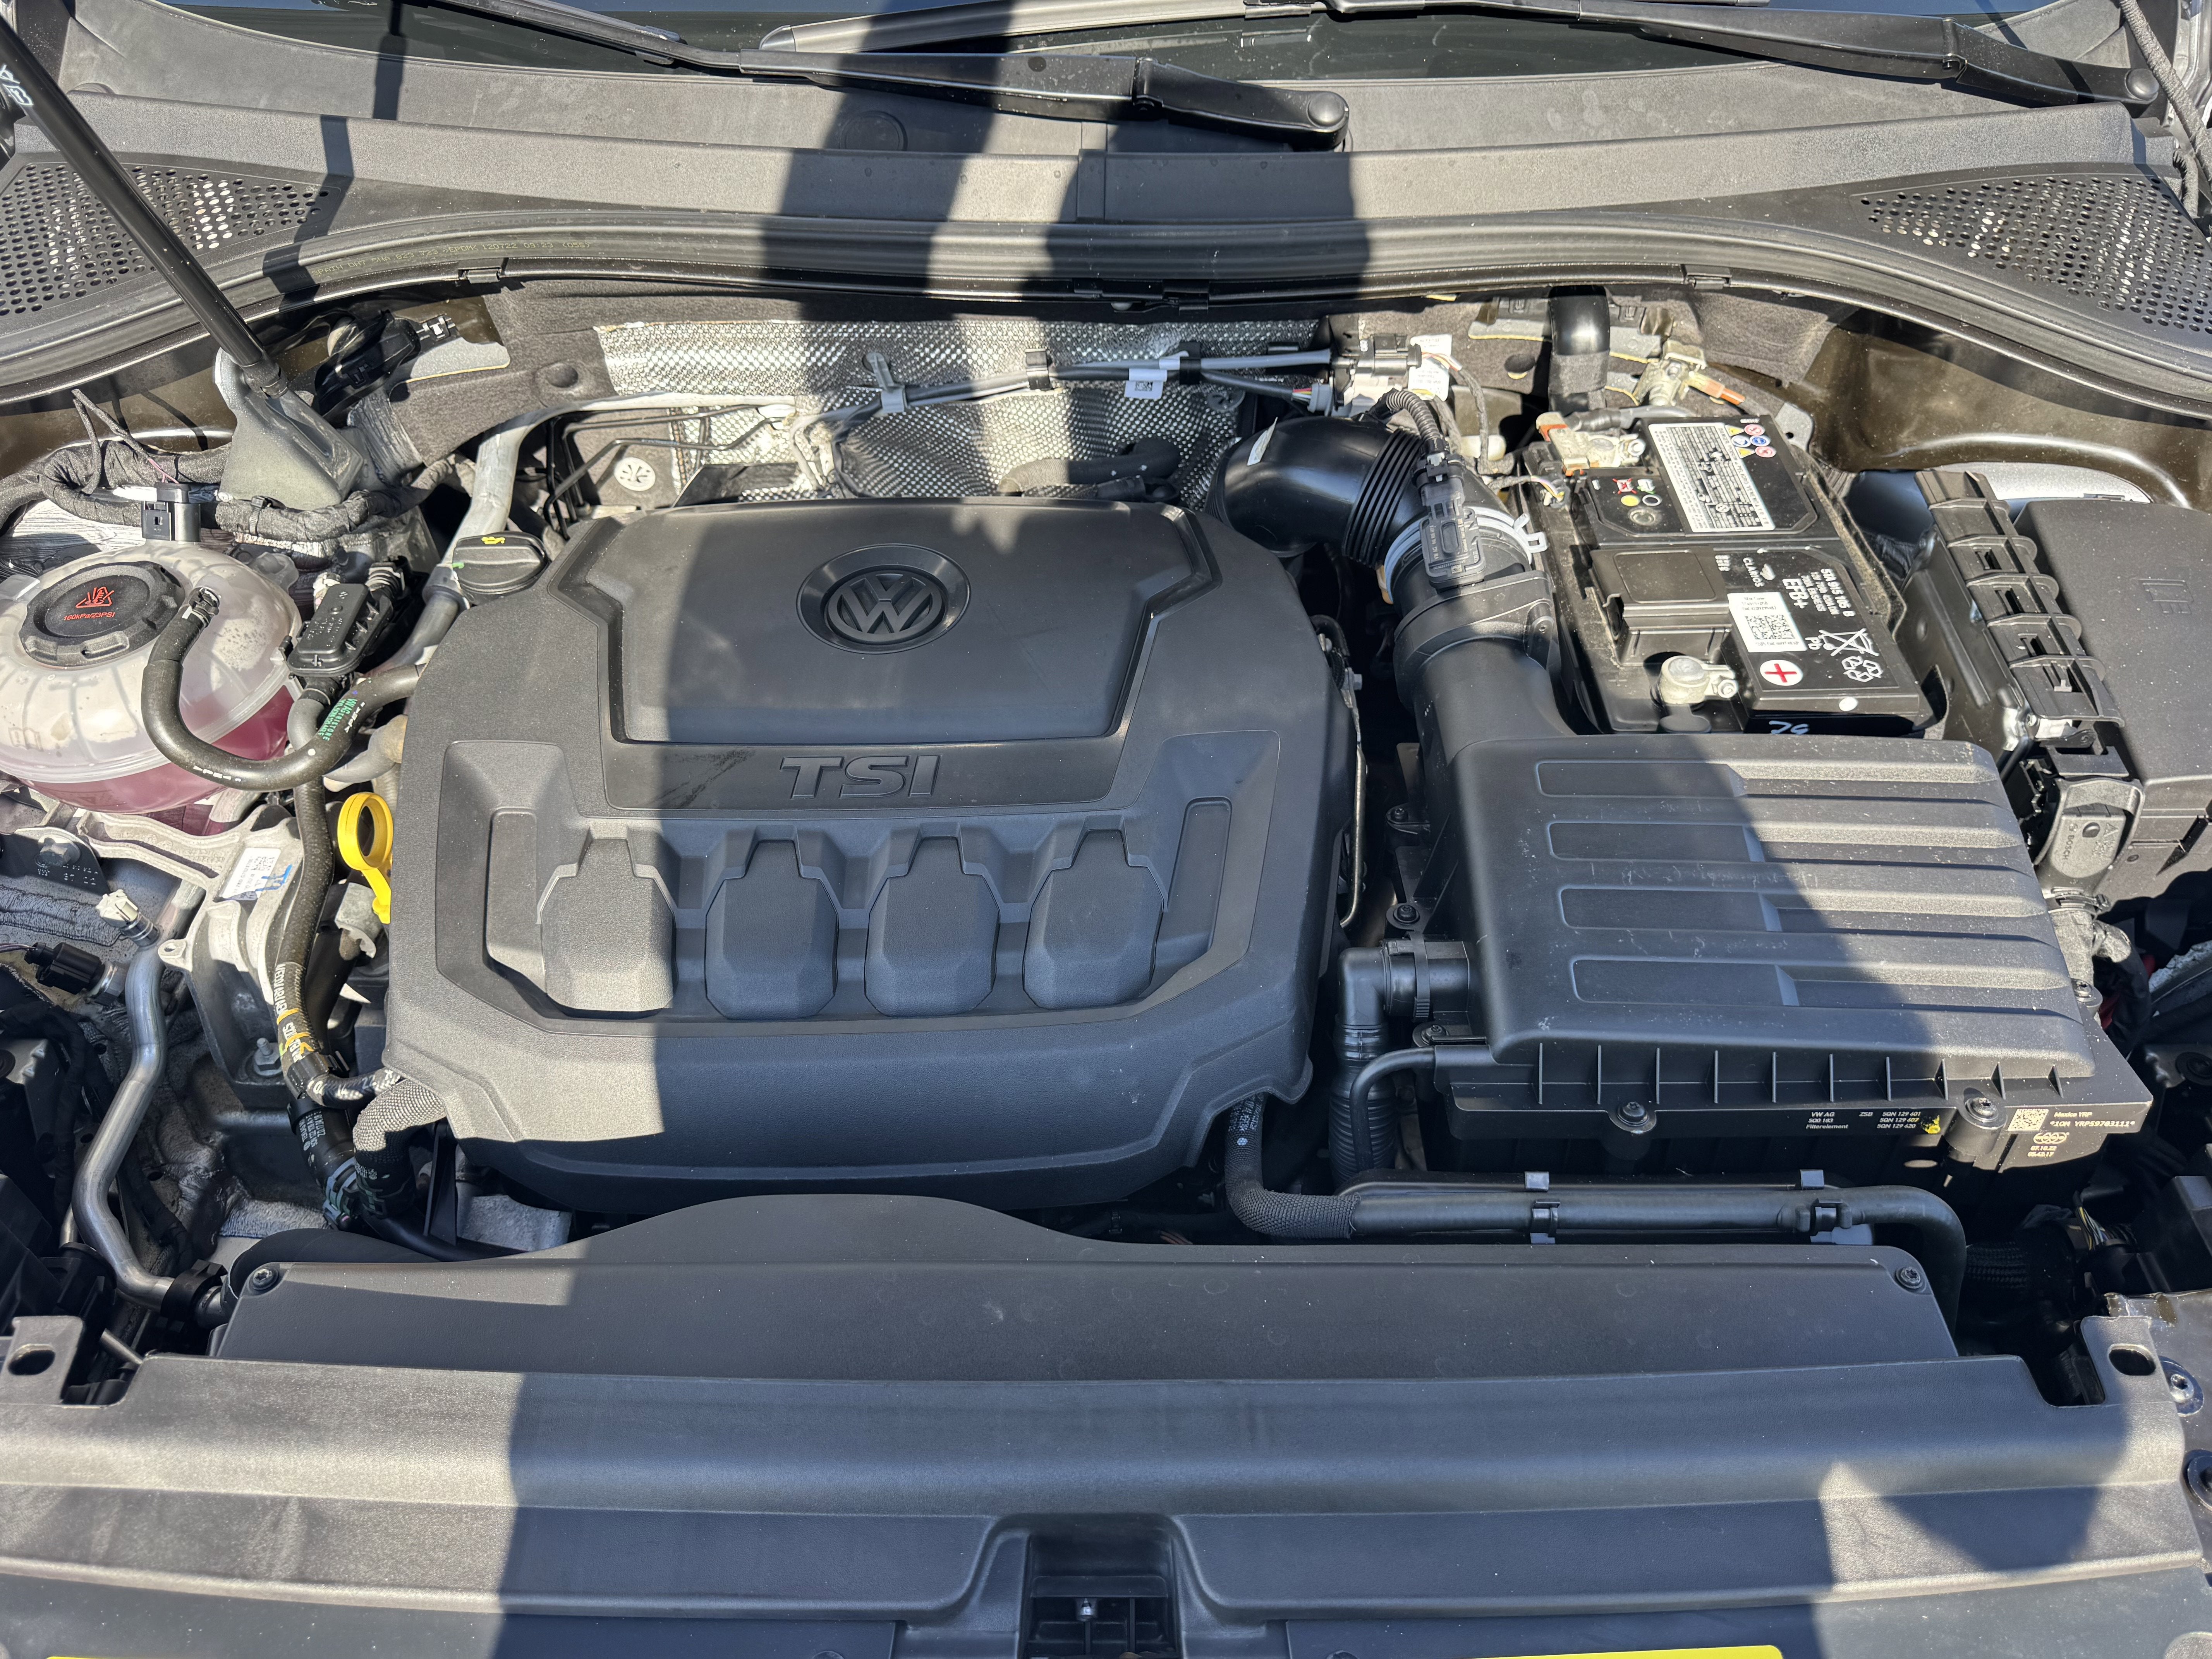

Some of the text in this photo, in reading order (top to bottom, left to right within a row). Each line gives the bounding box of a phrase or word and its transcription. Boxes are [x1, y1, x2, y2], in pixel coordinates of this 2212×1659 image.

[311, 264, 343, 276] SPAIN
[1743, 557, 1765, 587] CLARIOS
[1820, 568, 1837, 582] 5TA
[1782, 578, 1809, 609] EFB+
[1827, 581, 1844, 595] 915
[820, 565, 948, 646] VW
[1835, 595, 1851, 608] 105
[64, 612, 115, 621] 160kPa/23PSI
[1805, 637, 1824, 651] Pb
[780, 755, 942, 799] TSI
[2062, 835, 2075, 860] BOSCH
